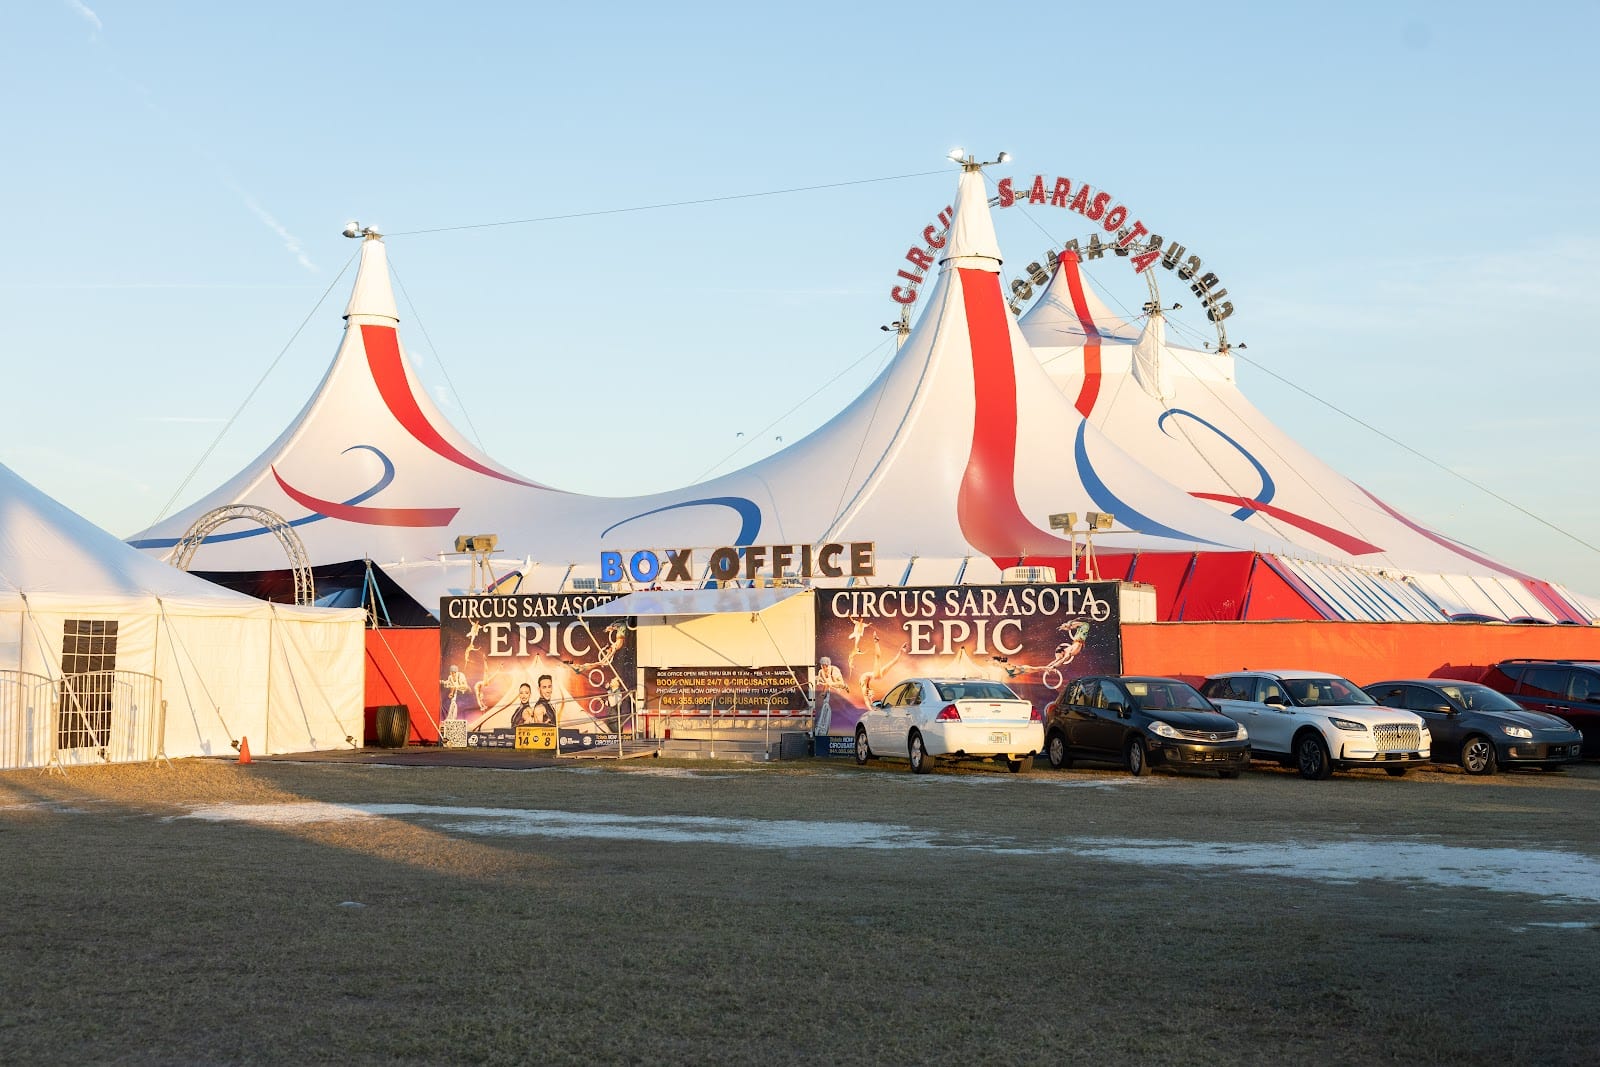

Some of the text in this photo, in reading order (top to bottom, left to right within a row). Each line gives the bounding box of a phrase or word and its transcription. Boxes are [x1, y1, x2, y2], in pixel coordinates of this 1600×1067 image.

[998, 175, 1160, 274] SARASOTA
[601, 542, 873, 582] BOX OFFICE
[449, 597, 518, 619] CIRCUS
[832, 587, 1100, 618] CIRCUS SARASOTA
[483, 620, 591, 657] EPIC
[903, 619, 1023, 656] EPIC
[656, 678, 677, 686] BOOK
[679, 678, 706, 686] ONLINE
[707, 678, 722, 686] 24/7
[731, 678, 796, 686] CIRCUSARTS.ORG
[719, 696, 789, 705] CIRCUSARTS.ORG
[518, 736, 529, 746] 14
[544, 737, 551, 747] 8
